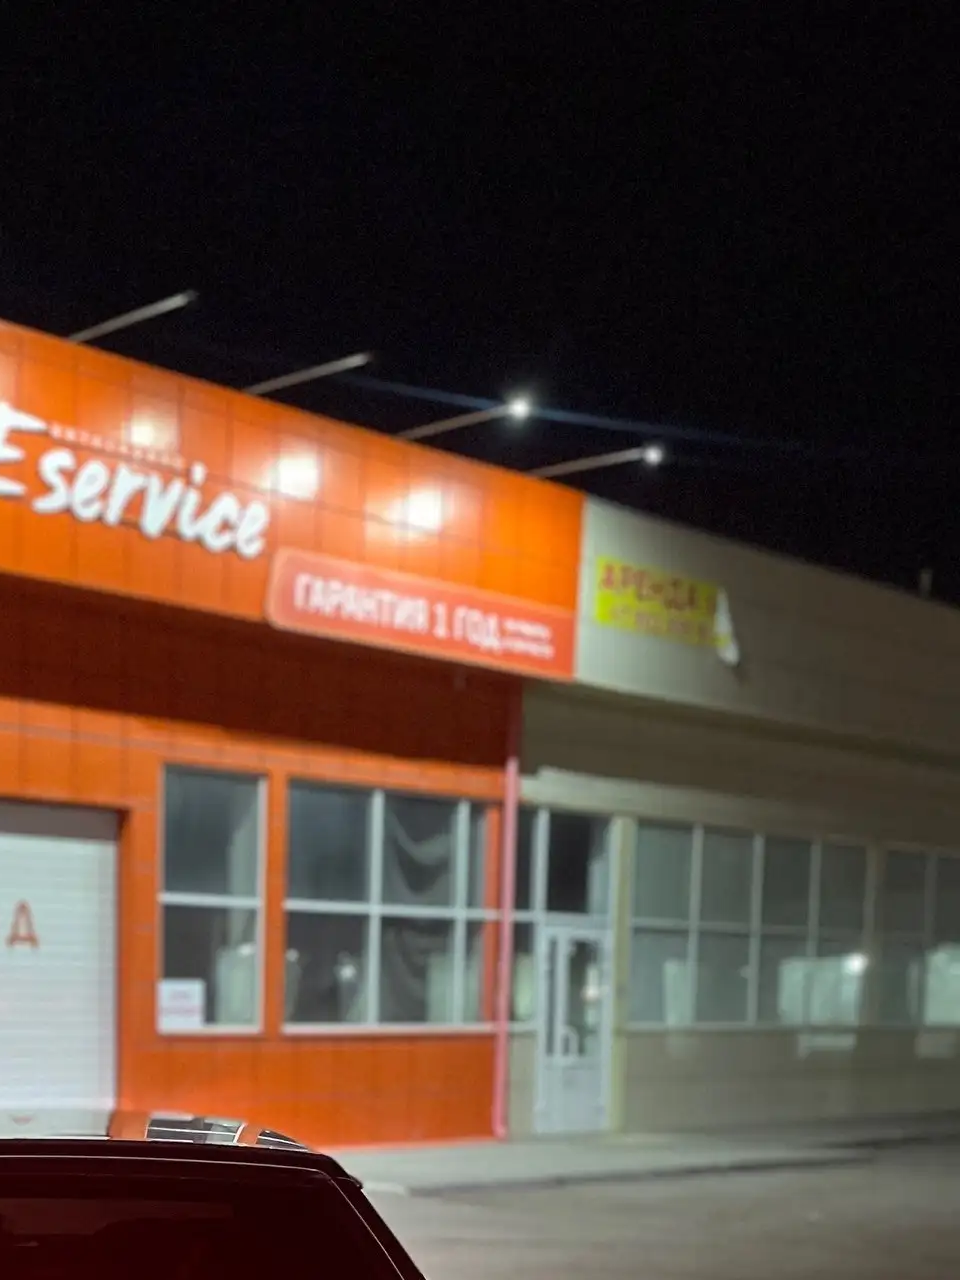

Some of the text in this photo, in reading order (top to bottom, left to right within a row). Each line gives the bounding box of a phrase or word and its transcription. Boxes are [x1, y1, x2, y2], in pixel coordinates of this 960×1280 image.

[32, 447, 271, 558] service
[293, 572, 429, 636] ГАРАНТИЯ
[433, 603, 450, 639] 1
[454, 606, 502, 655] ГОД
